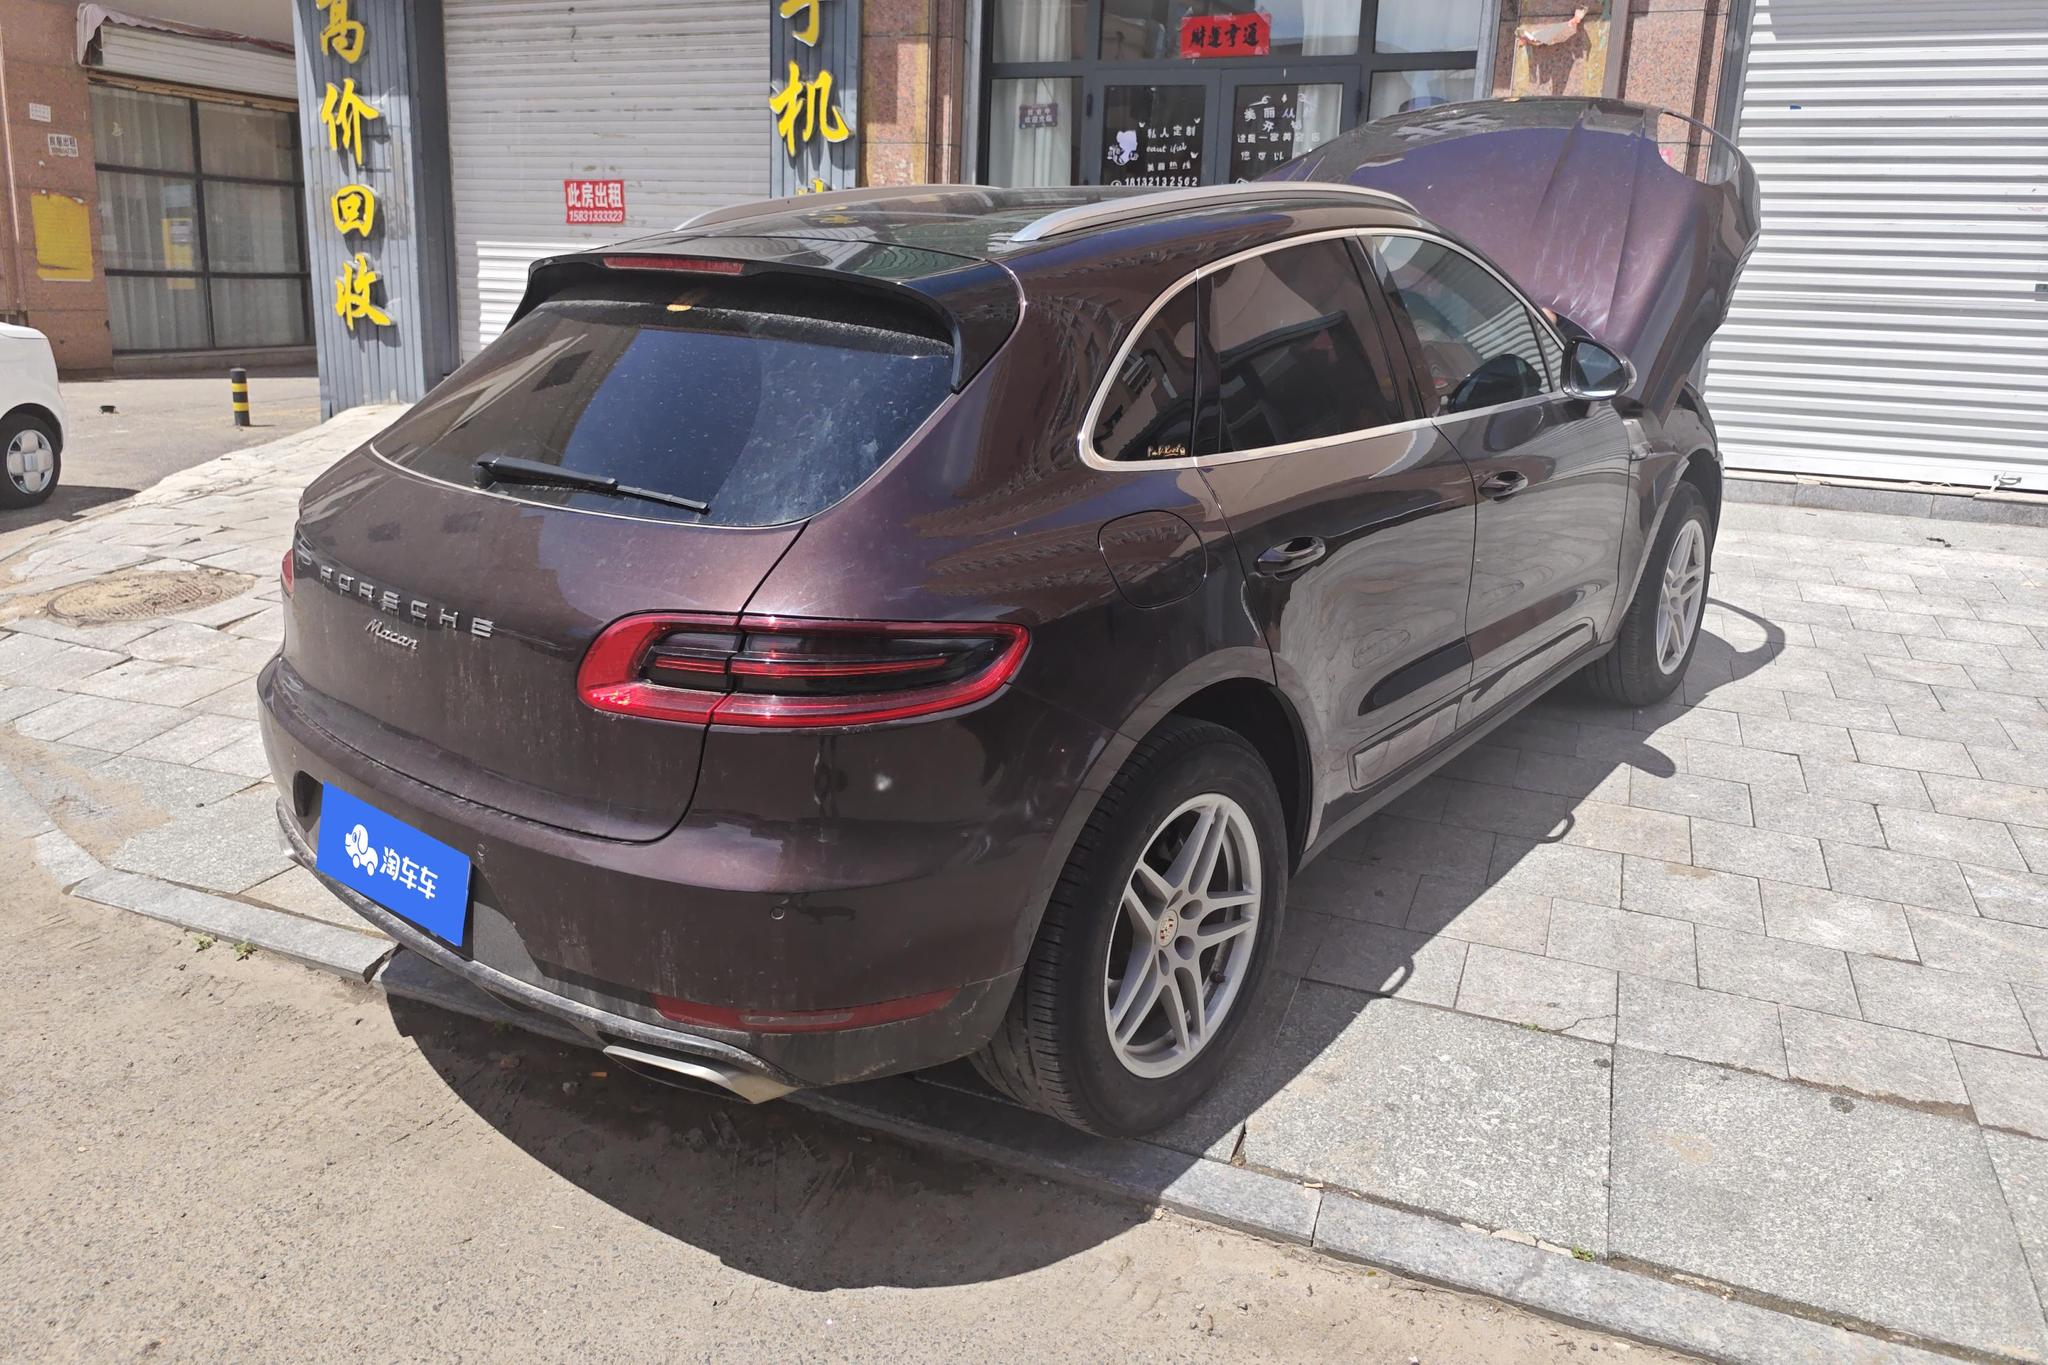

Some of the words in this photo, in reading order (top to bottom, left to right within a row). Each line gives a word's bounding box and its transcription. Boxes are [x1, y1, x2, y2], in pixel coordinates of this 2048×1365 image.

[315, 0, 391, 331] 高价回收
[567, 182, 623, 208] 此房出租
[320, 565, 495, 637] PORSCHE
[365, 618, 418, 650] Macan
